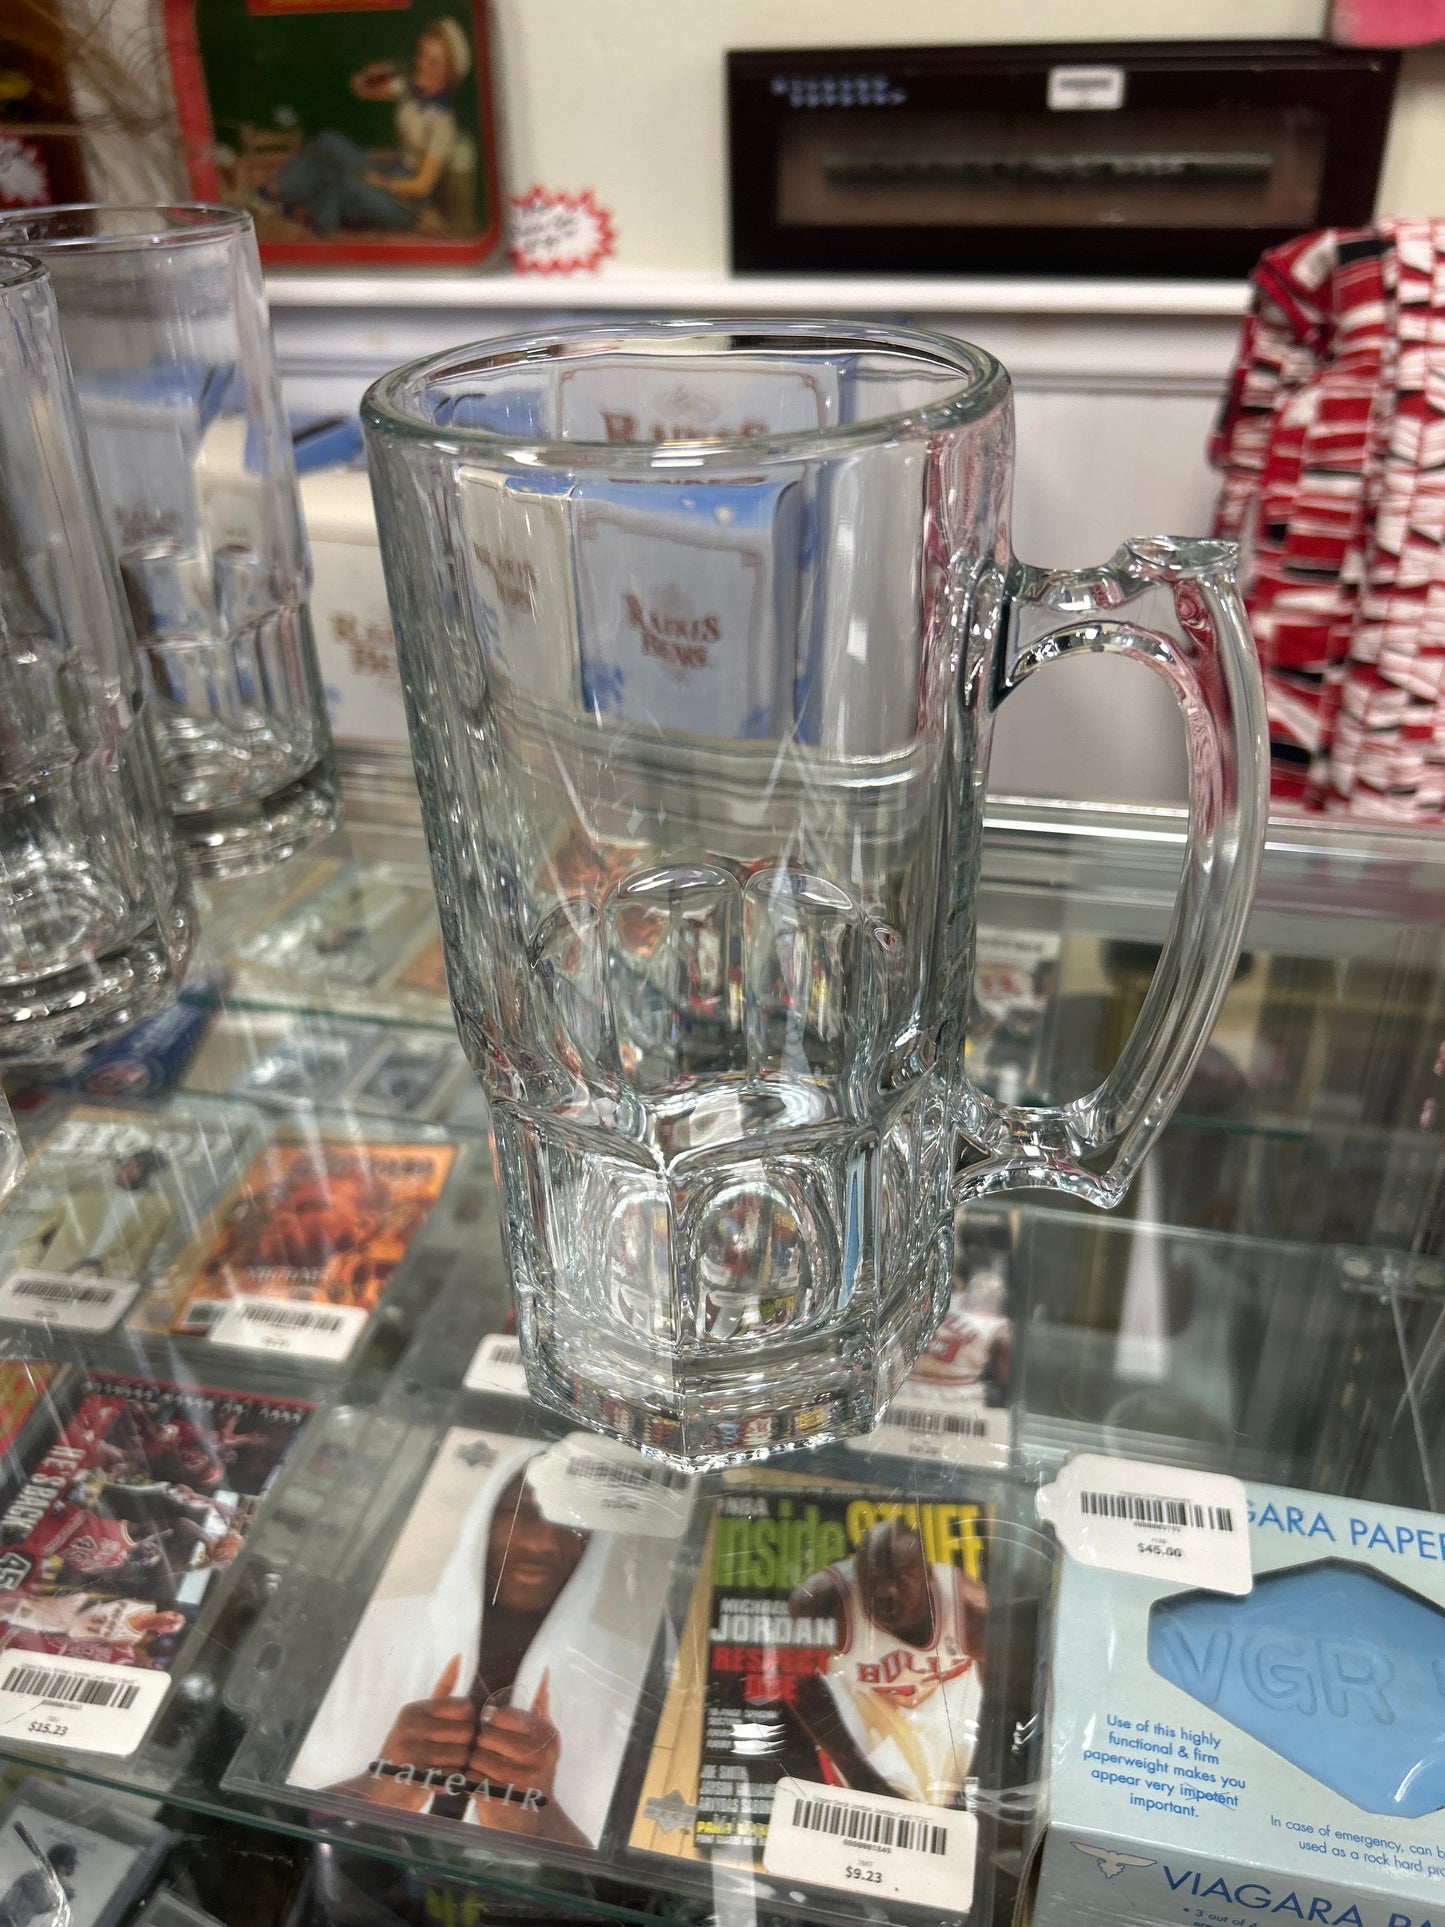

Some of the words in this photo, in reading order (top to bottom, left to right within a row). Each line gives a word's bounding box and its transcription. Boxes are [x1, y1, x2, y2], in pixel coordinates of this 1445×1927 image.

[710, 1614, 837, 1646] JORDAN
[1106, 1713, 1131, 1729] Use
[1136, 1719, 1150, 1732] of
[1154, 1722, 1176, 1738] this
[1180, 1727, 1221, 1749] highly
[1108, 1731, 1172, 1755] functional
[1178, 1745, 1189, 1759] &
[1193, 1748, 1219, 1765] firm
[1083, 1749, 1168, 1774] paperweight
[1173, 1766, 1216, 1783] makes
[1220, 1775, 1246, 1789] you
[1091, 1769, 1141, 1785] appear
[1145, 1779, 1175, 1796] very
[1180, 1783, 1239, 1807] impotent
[1130, 1793, 1199, 1818] important.
[1270, 1814, 1281, 1827] In
[1286, 1820, 1314, 1833] case
[1318, 1825, 1330, 1837] of
[1335, 1830, 1404, 1853] emergency,
[1409, 1845, 1432, 1857] can
[1299, 1840, 1327, 1854] used
[1332, 1847, 1346, 1858] as
[1351, 1851, 1359, 1860] a
[1364, 1853, 1390, 1866] rock
[1394, 1855, 1423, 1873] hard
[845, 1865, 883, 1884] $9.23
[1163, 1865, 1364, 1927] VIAGARA
[1208, 1913, 1229, 1923] out
[1232, 1918, 1246, 1927] of
